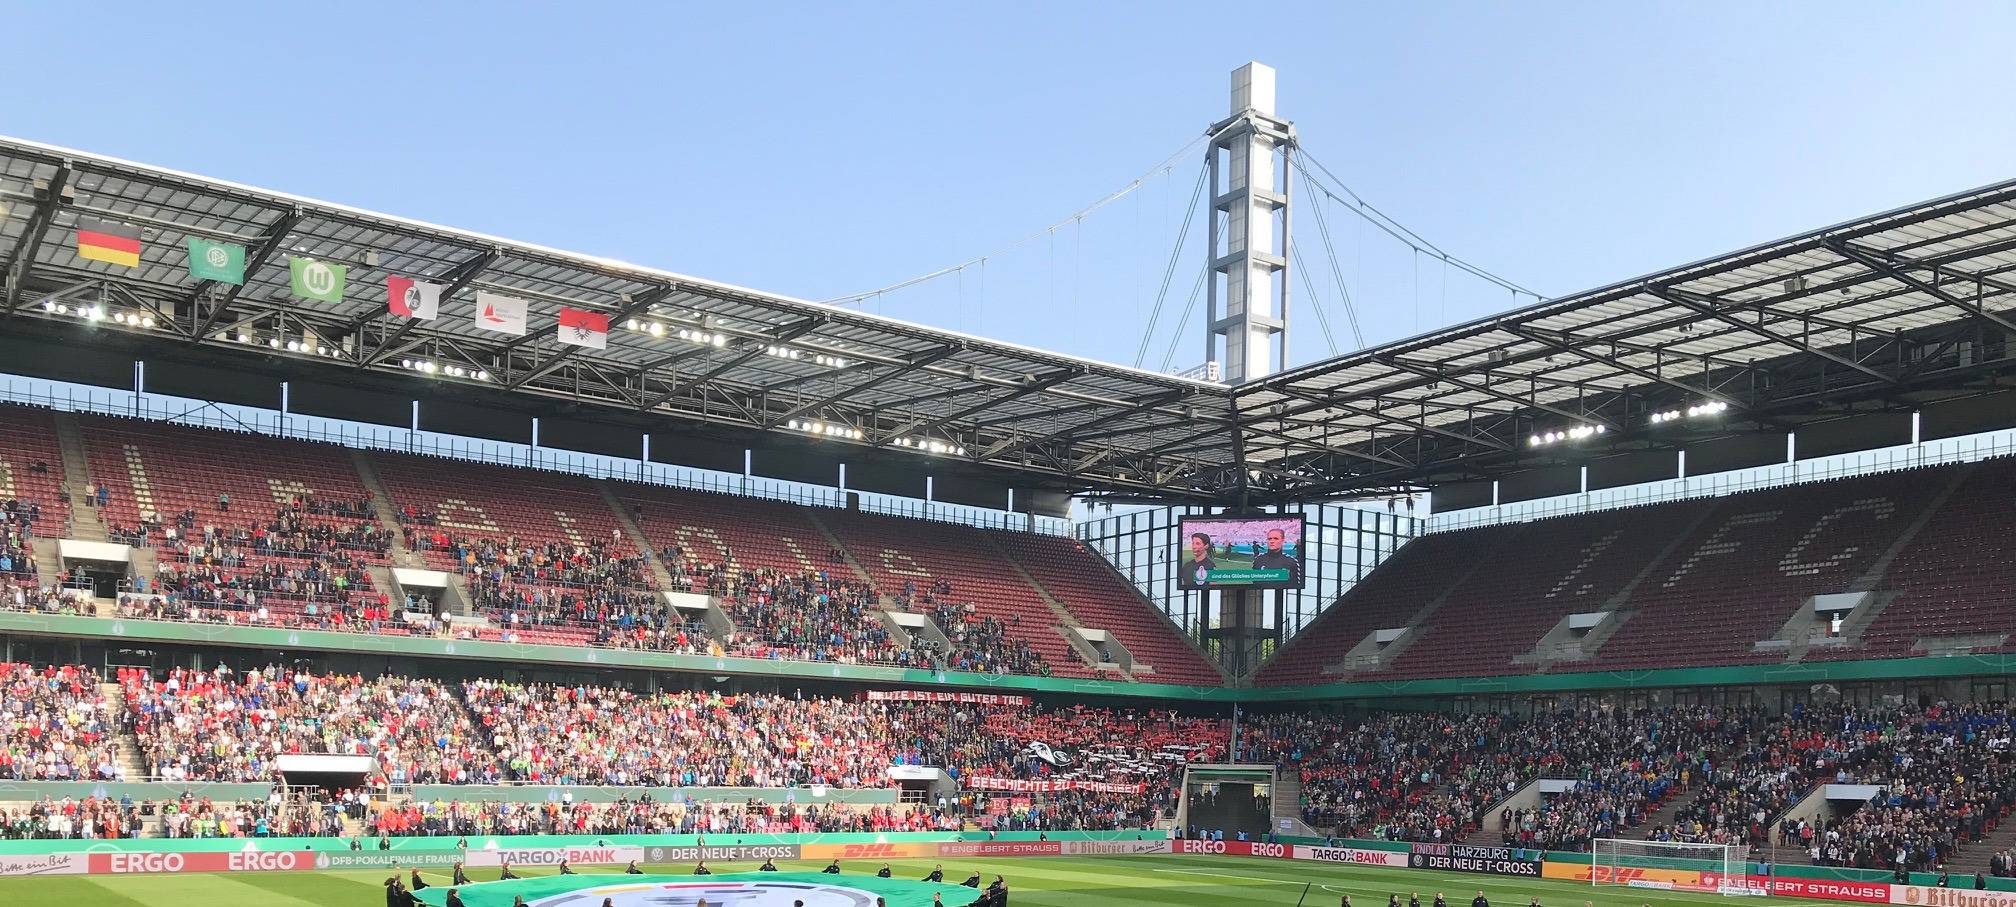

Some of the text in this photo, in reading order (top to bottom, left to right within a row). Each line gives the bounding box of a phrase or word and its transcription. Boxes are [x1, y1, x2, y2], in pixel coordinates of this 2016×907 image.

[867, 690, 1023, 706] HEUTE IST EIN GUTER TAG
[971, 776, 1050, 791] GESCHICHTE
[1054, 780, 1070, 791] ZU
[672, 848, 698, 860] DER
[702, 847, 738, 859] NEUE
[741, 846, 795, 858] T-CROSS.
[843, 843, 897, 858] DHL
[951, 844, 1059, 854] ENGELBERT STRAUSS
[1183, 840, 1226, 854] ERGO
[1251, 842, 1284, 857] ERGO
[1452, 845, 1509, 860] HARZBURG
[111, 853, 184, 872] ERGO
[228, 851, 296, 870] ERGO
[332, 854, 464, 865] DFB-POKALFINALE FRAUEN
[1429, 856, 1451, 868] DER
[1453, 858, 1483, 871] NEUE
[1486, 860, 1537, 875] T-CROSS.
[1808, 884, 1886, 898] STRAUSS
